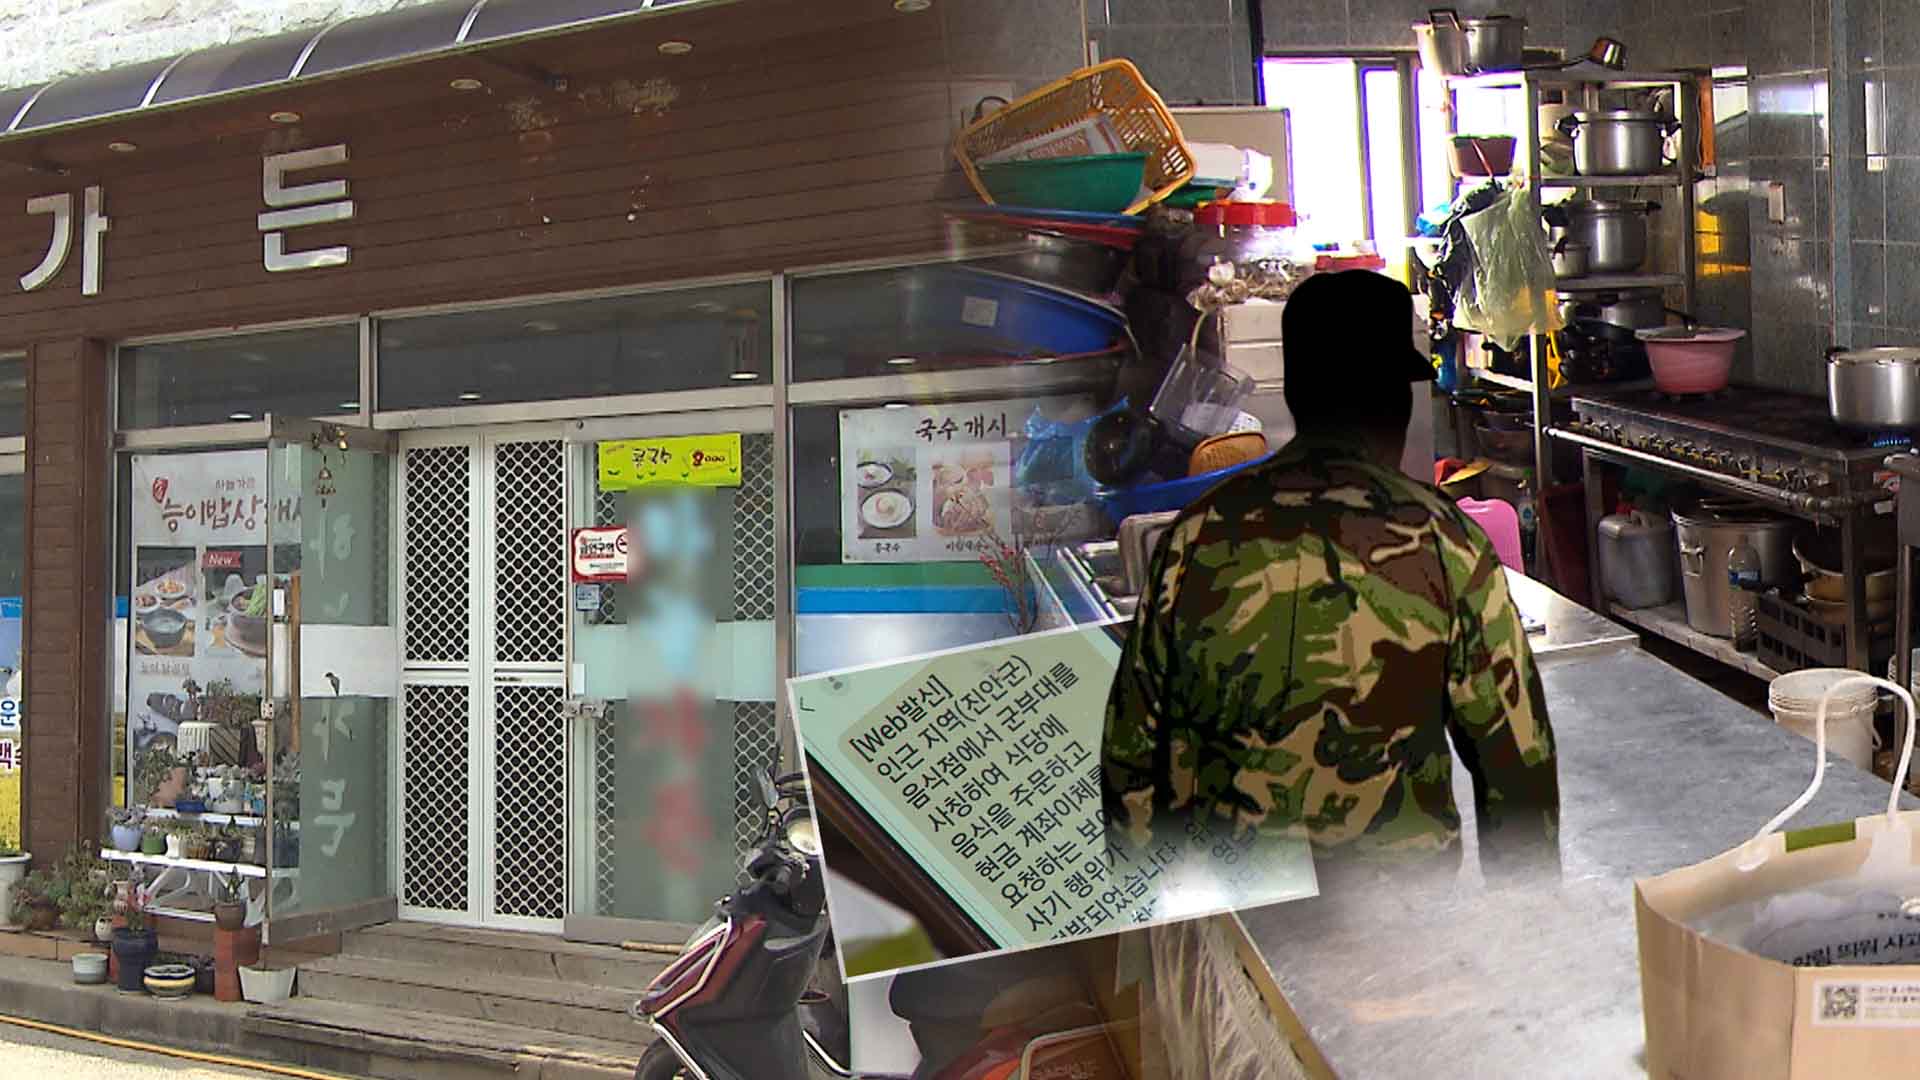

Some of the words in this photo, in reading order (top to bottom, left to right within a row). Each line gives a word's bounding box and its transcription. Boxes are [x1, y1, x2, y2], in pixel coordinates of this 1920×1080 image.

[20, 143, 354, 294] 가든
[915, 417, 959, 442] 국수
[963, 412, 1007, 440] 개시
[208, 554, 233, 566] New
[848, 674, 954, 763] [Web발신]
[877, 742, 925, 784] 인근
[917, 655, 1032, 749] 지역(진안군)
[902, 723, 1002, 810] 음식점에서
[996, 662, 1079, 732] 군부대를
[928, 762, 1010, 832] 사칭하여
[1006, 713, 1069, 766] 식당에
[951, 803, 1016, 859] 음식을
[1010, 740, 1092, 807] 주문하고
[975, 841, 1022, 883] 현금
[1001, 841, 1083, 909] 요청하는
[1025, 890, 1073, 932] 사기
[1063, 843, 1129, 898] 행위가
[1050, 843, 1177, 940] 발되었습니다
